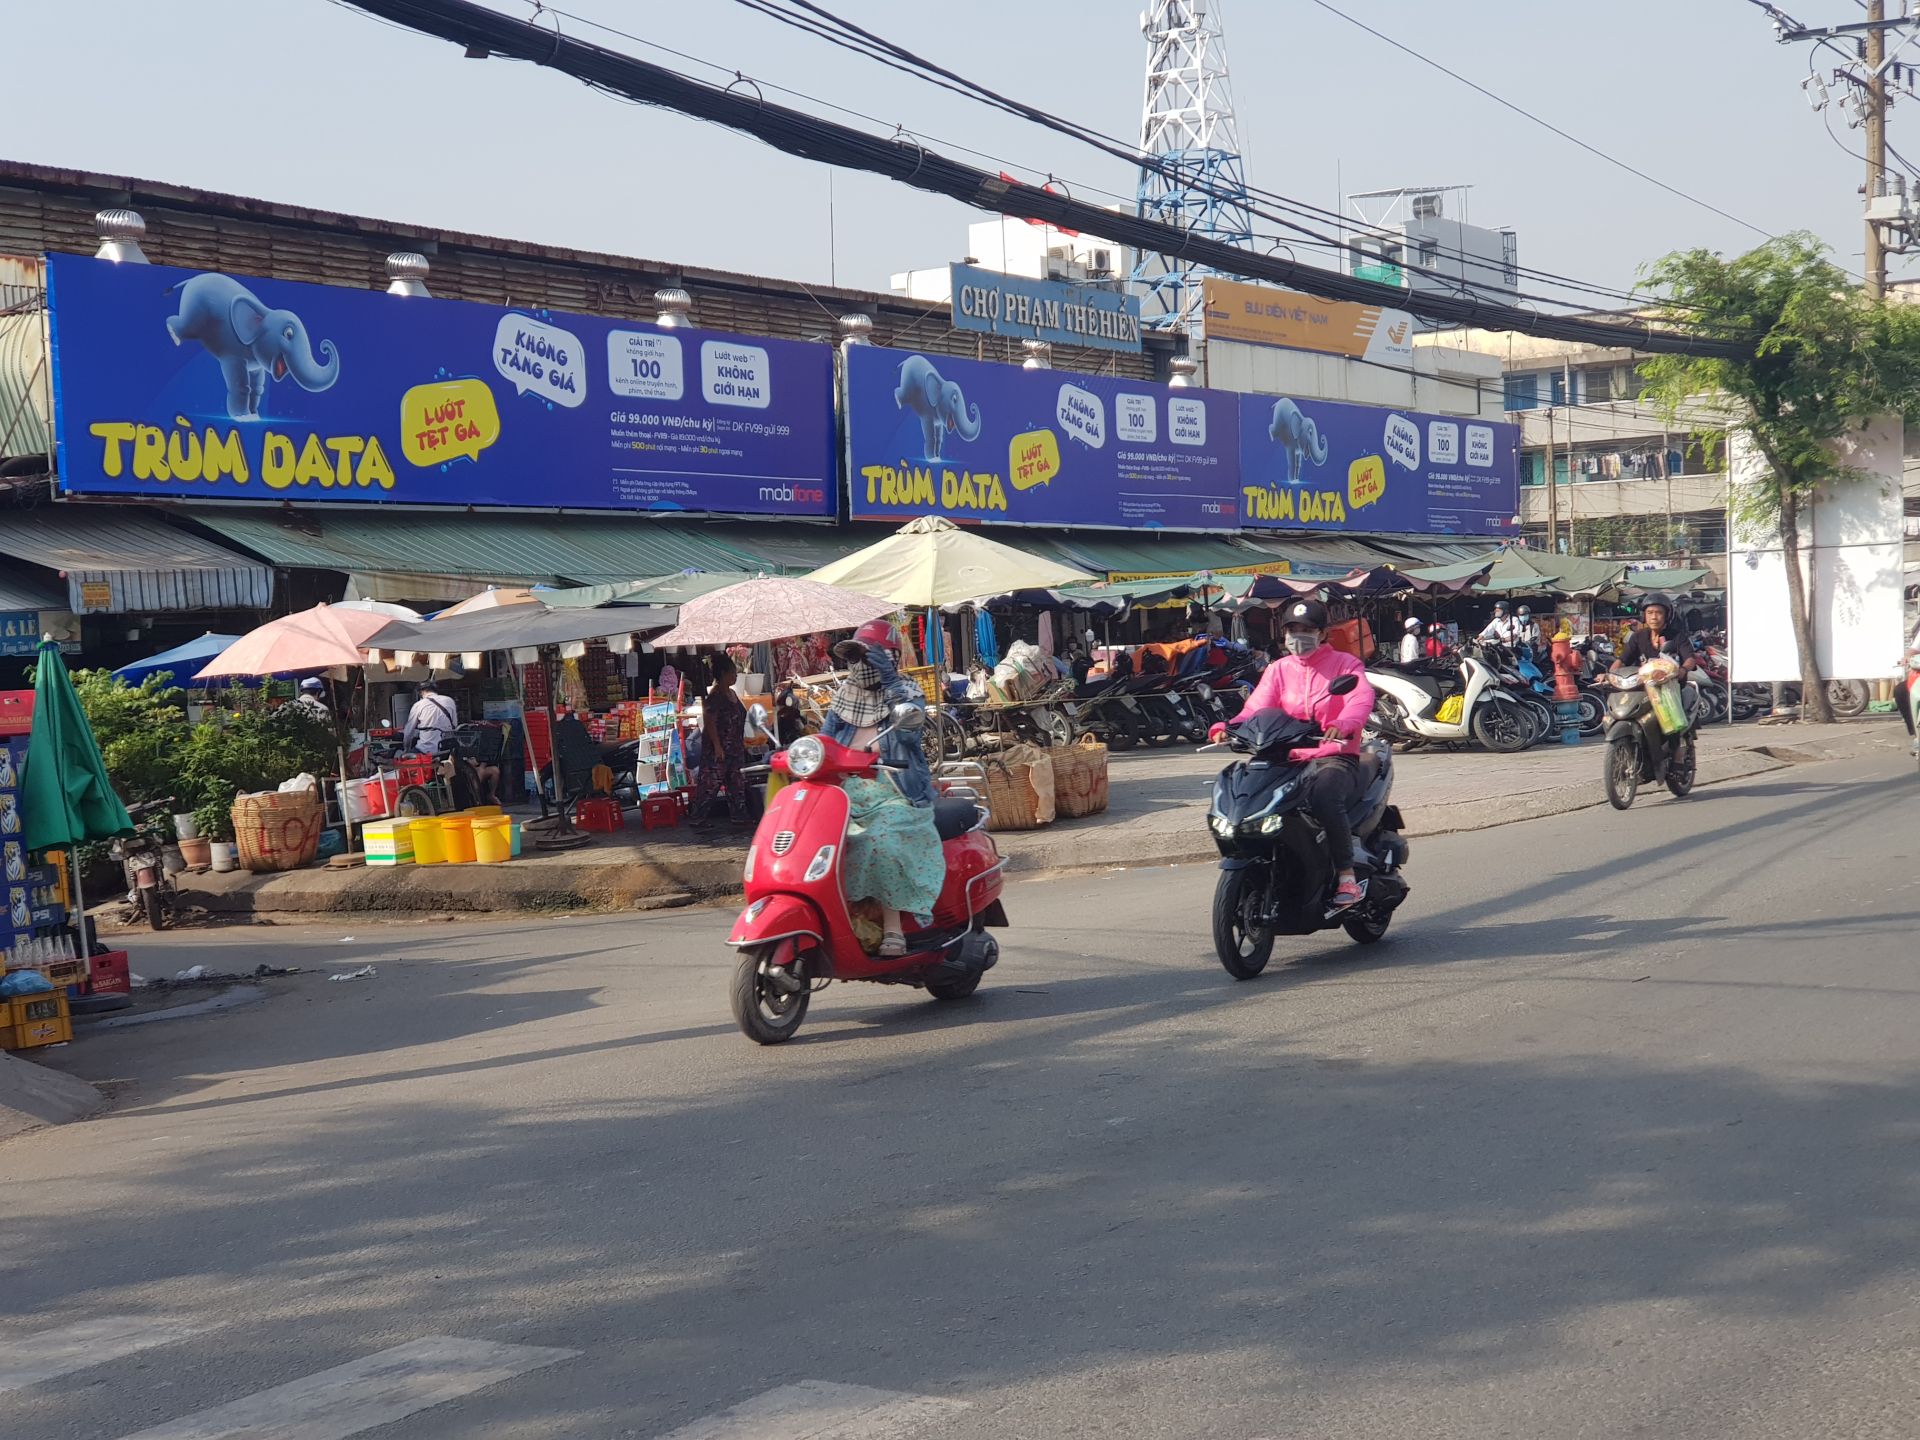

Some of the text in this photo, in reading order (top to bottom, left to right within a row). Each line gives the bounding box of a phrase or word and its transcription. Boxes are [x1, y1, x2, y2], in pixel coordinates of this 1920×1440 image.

[961, 285, 1000, 332] CHỢ
[1004, 293, 1060, 337] PHẠM
[1309, 314, 1328, 325] NAM
[515, 329, 568, 366] KHÔNG
[645, 338, 654, 347] TRÍ
[732, 354, 748, 363] web
[501, 347, 576, 393] TĂNG GIÁ
[631, 359, 661, 379] 100
[717, 365, 755, 381] KHÔNG
[713, 381, 760, 401] GIỚI HẠN
[424, 398, 465, 427] LƯỚT
[1068, 394, 1095, 419] KHÔNG
[610, 411, 626, 423] Giá
[628, 413, 659, 425] 99.000
[662, 415, 700, 428] VNĐ/chu
[744, 422, 763, 433] FV99
[776, 425, 790, 435] 999
[1061, 407, 1100, 439] TĂNG GIÁ
[1128, 414, 1144, 427] 100
[1177, 414, 1198, 426] KHÔNG
[416, 420, 480, 450] TẸT GA
[632, 441, 645, 449] 500
[1437, 439, 1449, 451] 100
[89, 415, 395, 489] TRÙM DATA
[1021, 443, 1042, 462] LƯỚT
[1017, 458, 1050, 479] TẸT GA
[759, 483, 823, 502] mobifone
[861, 459, 1007, 511] TRÙM DATA
[1243, 481, 1346, 523] TRÙM DATA
